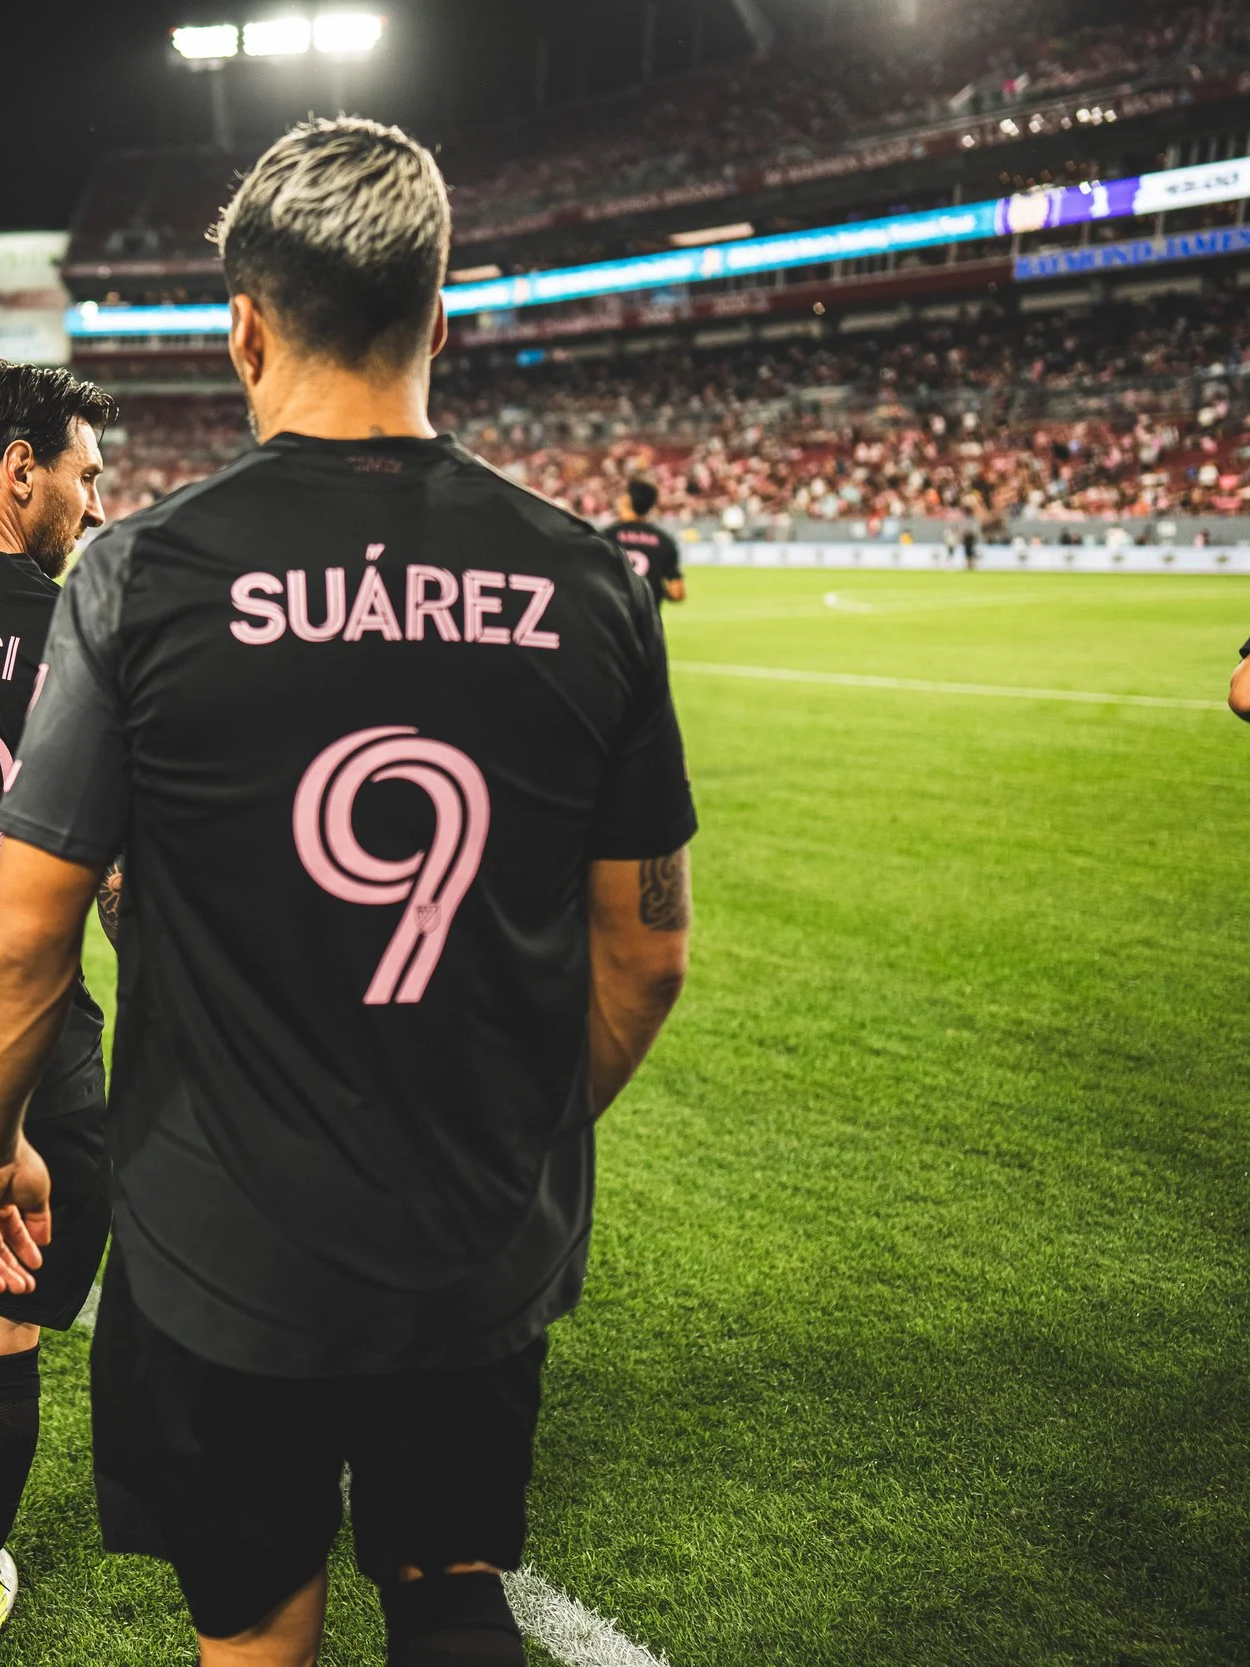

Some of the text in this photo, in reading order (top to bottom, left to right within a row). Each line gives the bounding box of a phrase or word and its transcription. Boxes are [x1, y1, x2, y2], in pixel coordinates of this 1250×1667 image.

[1014, 241, 1152, 280] RAYMOND
[229, 543, 561, 650] SUÁREZ
[291, 724, 492, 1005] 9
